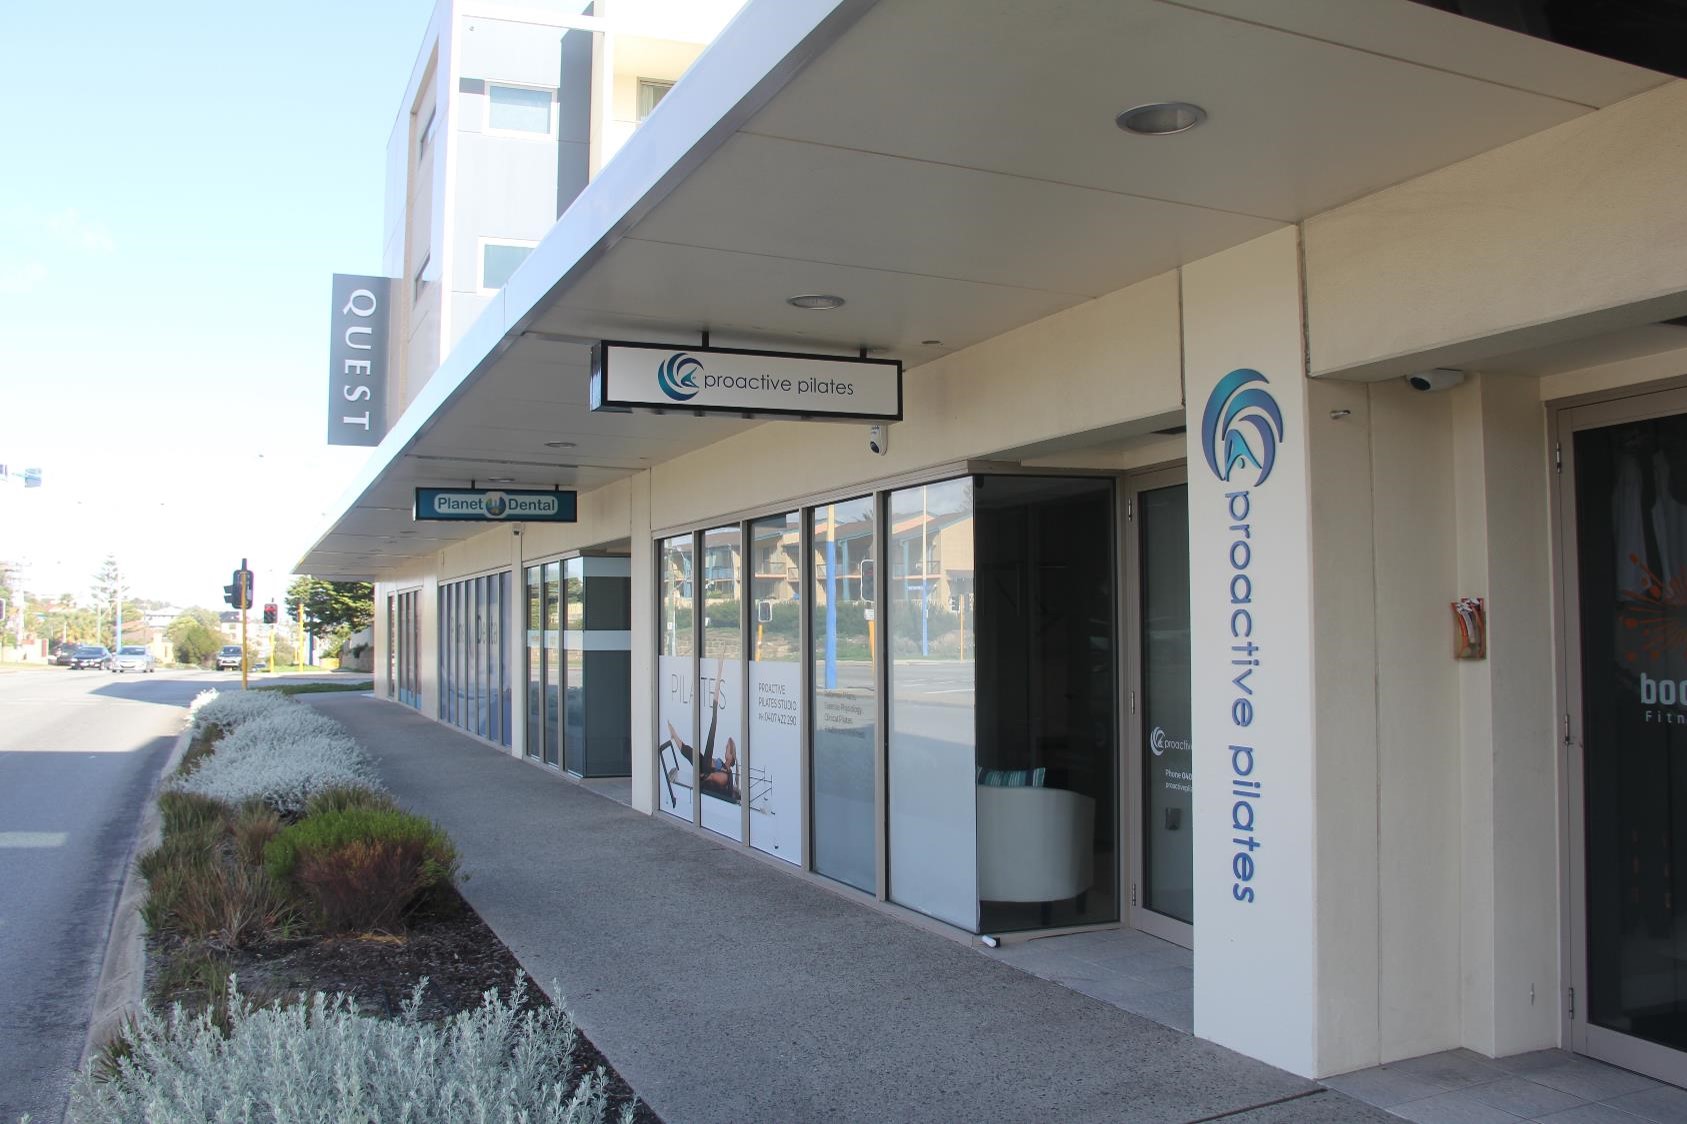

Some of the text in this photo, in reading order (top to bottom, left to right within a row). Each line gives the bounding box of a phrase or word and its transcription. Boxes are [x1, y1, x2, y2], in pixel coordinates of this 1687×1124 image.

[342, 288, 377, 431] QUEST
[703, 373, 854, 396] proactive pilates
[438, 497, 555, 512] Planet Dental
[1224, 490, 1261, 904] proactive pilates
[1165, 768, 1181, 779] Phone
